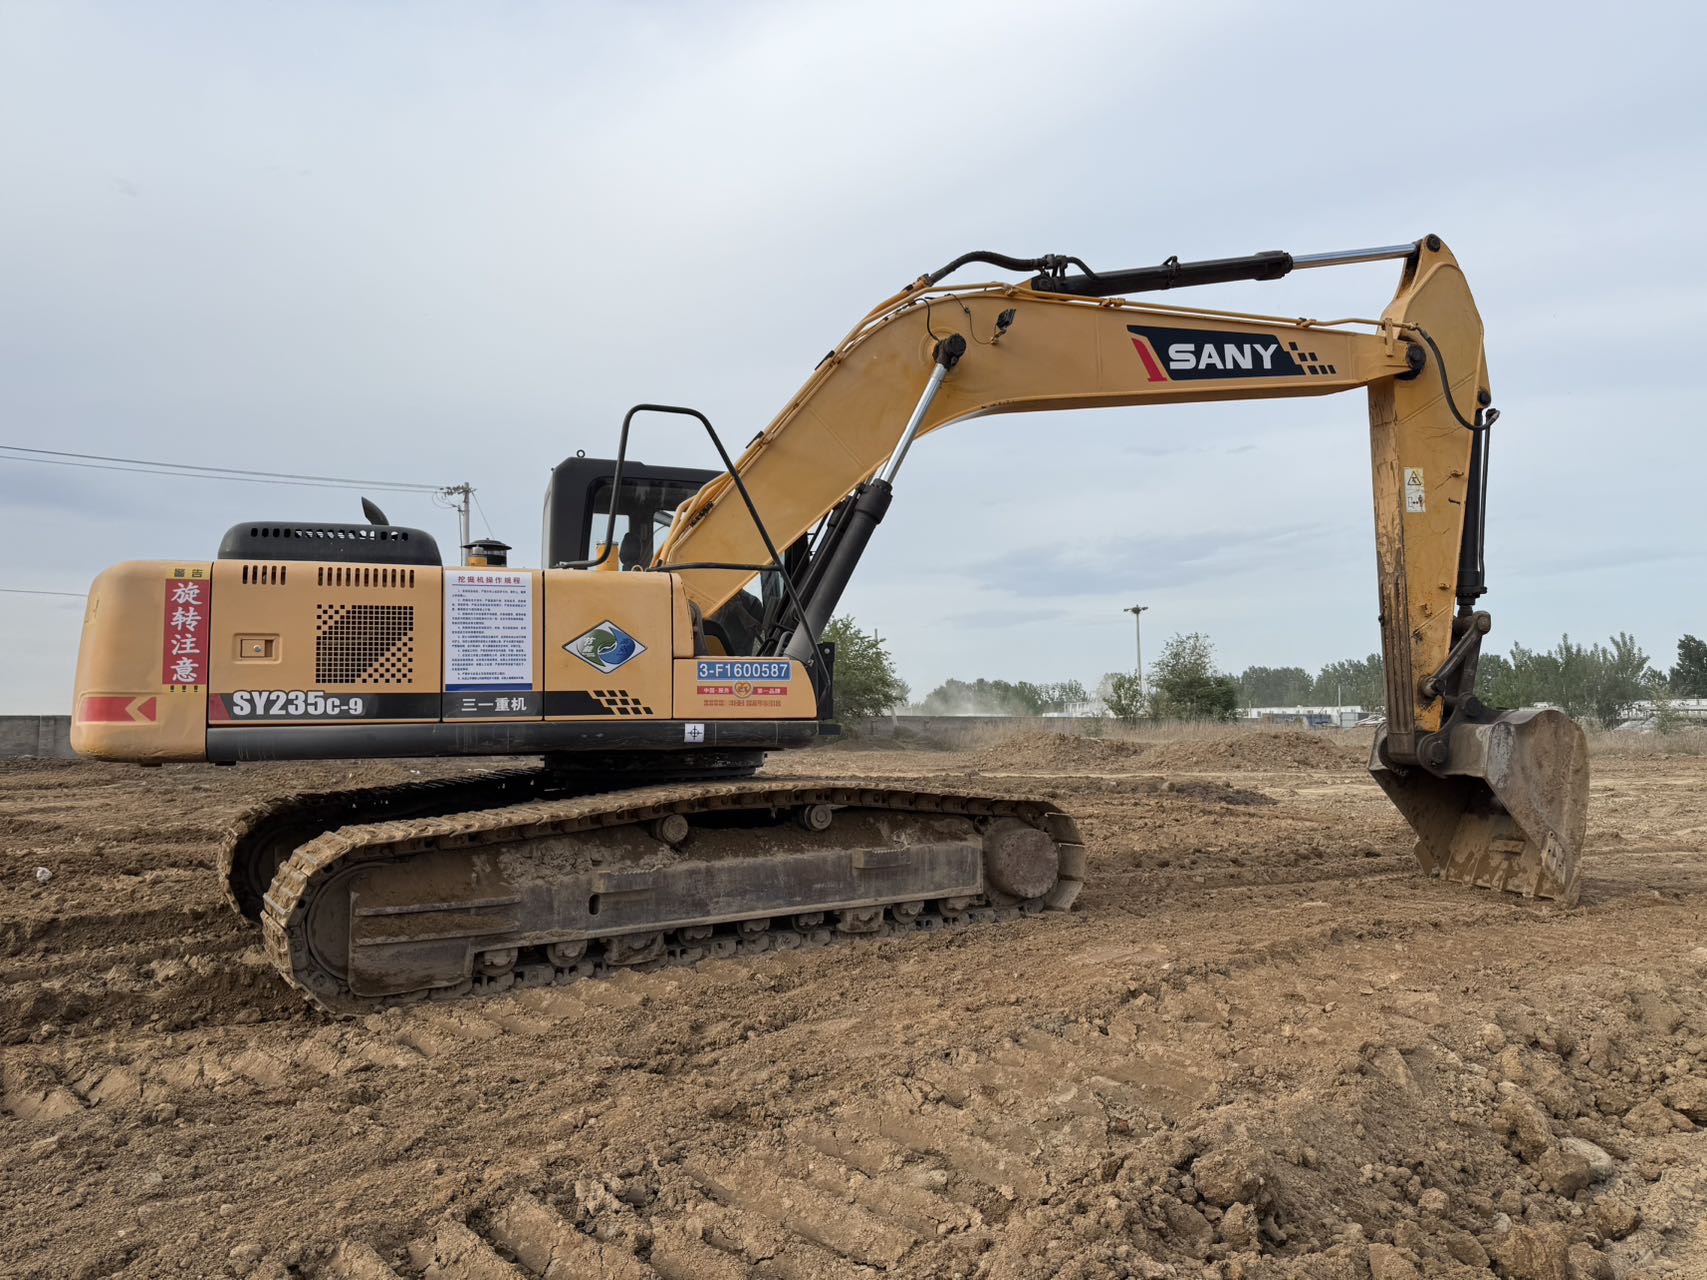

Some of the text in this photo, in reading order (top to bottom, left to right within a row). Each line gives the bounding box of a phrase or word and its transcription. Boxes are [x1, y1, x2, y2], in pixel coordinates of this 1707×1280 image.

[1168, 343, 1278, 369] SANY
[170, 582, 203, 683] 旋转注意
[699, 663, 788, 678] 3-F1600587
[461, 697, 527, 711] 三一重机
